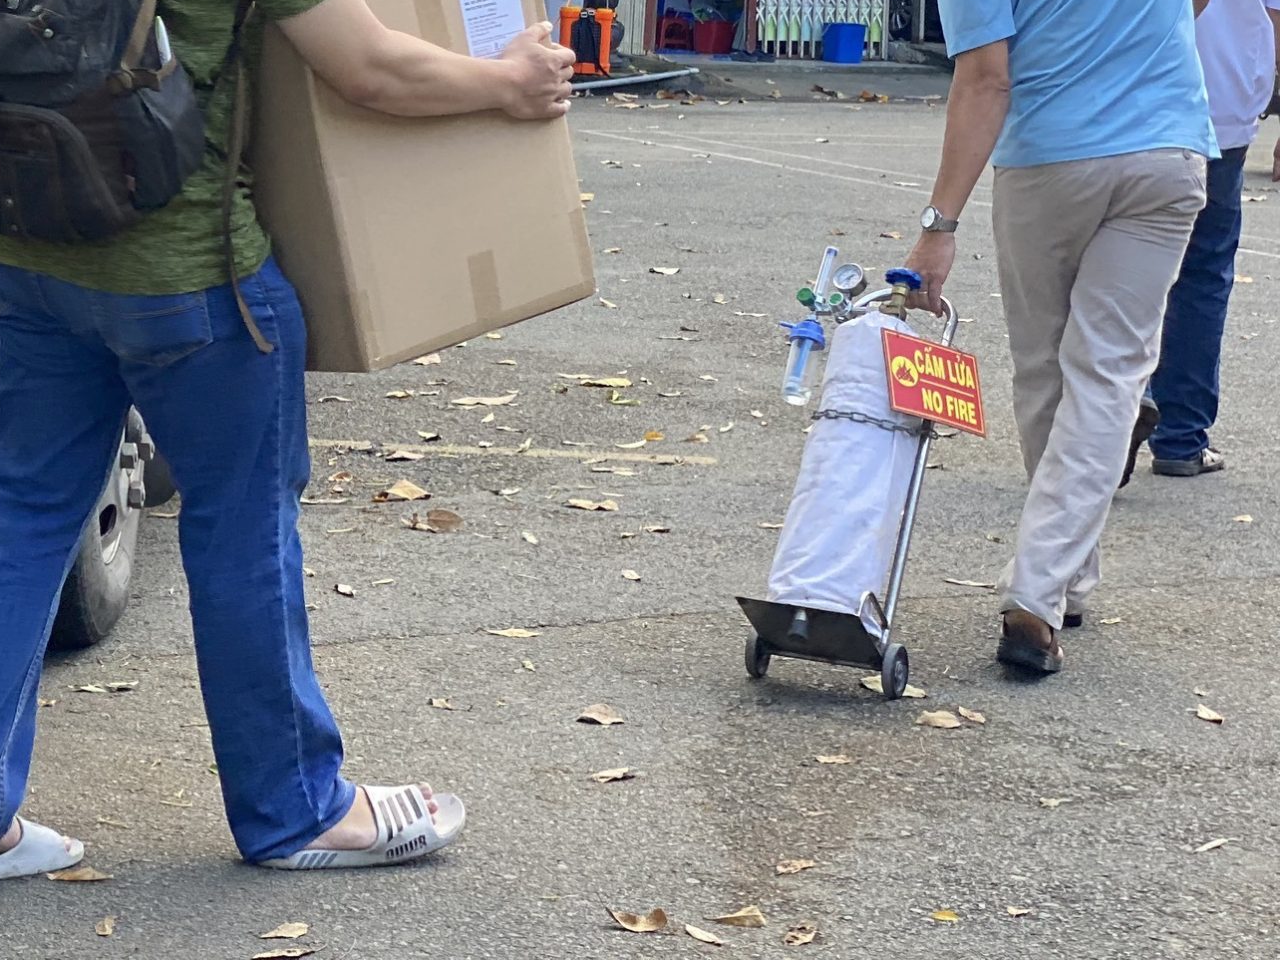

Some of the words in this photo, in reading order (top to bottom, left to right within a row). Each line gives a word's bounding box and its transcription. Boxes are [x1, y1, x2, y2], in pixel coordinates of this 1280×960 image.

[914, 346, 946, 380] CẤM
[947, 354, 976, 390] LỬA
[922, 387, 943, 415] NO
[945, 394, 977, 425] FIRE
